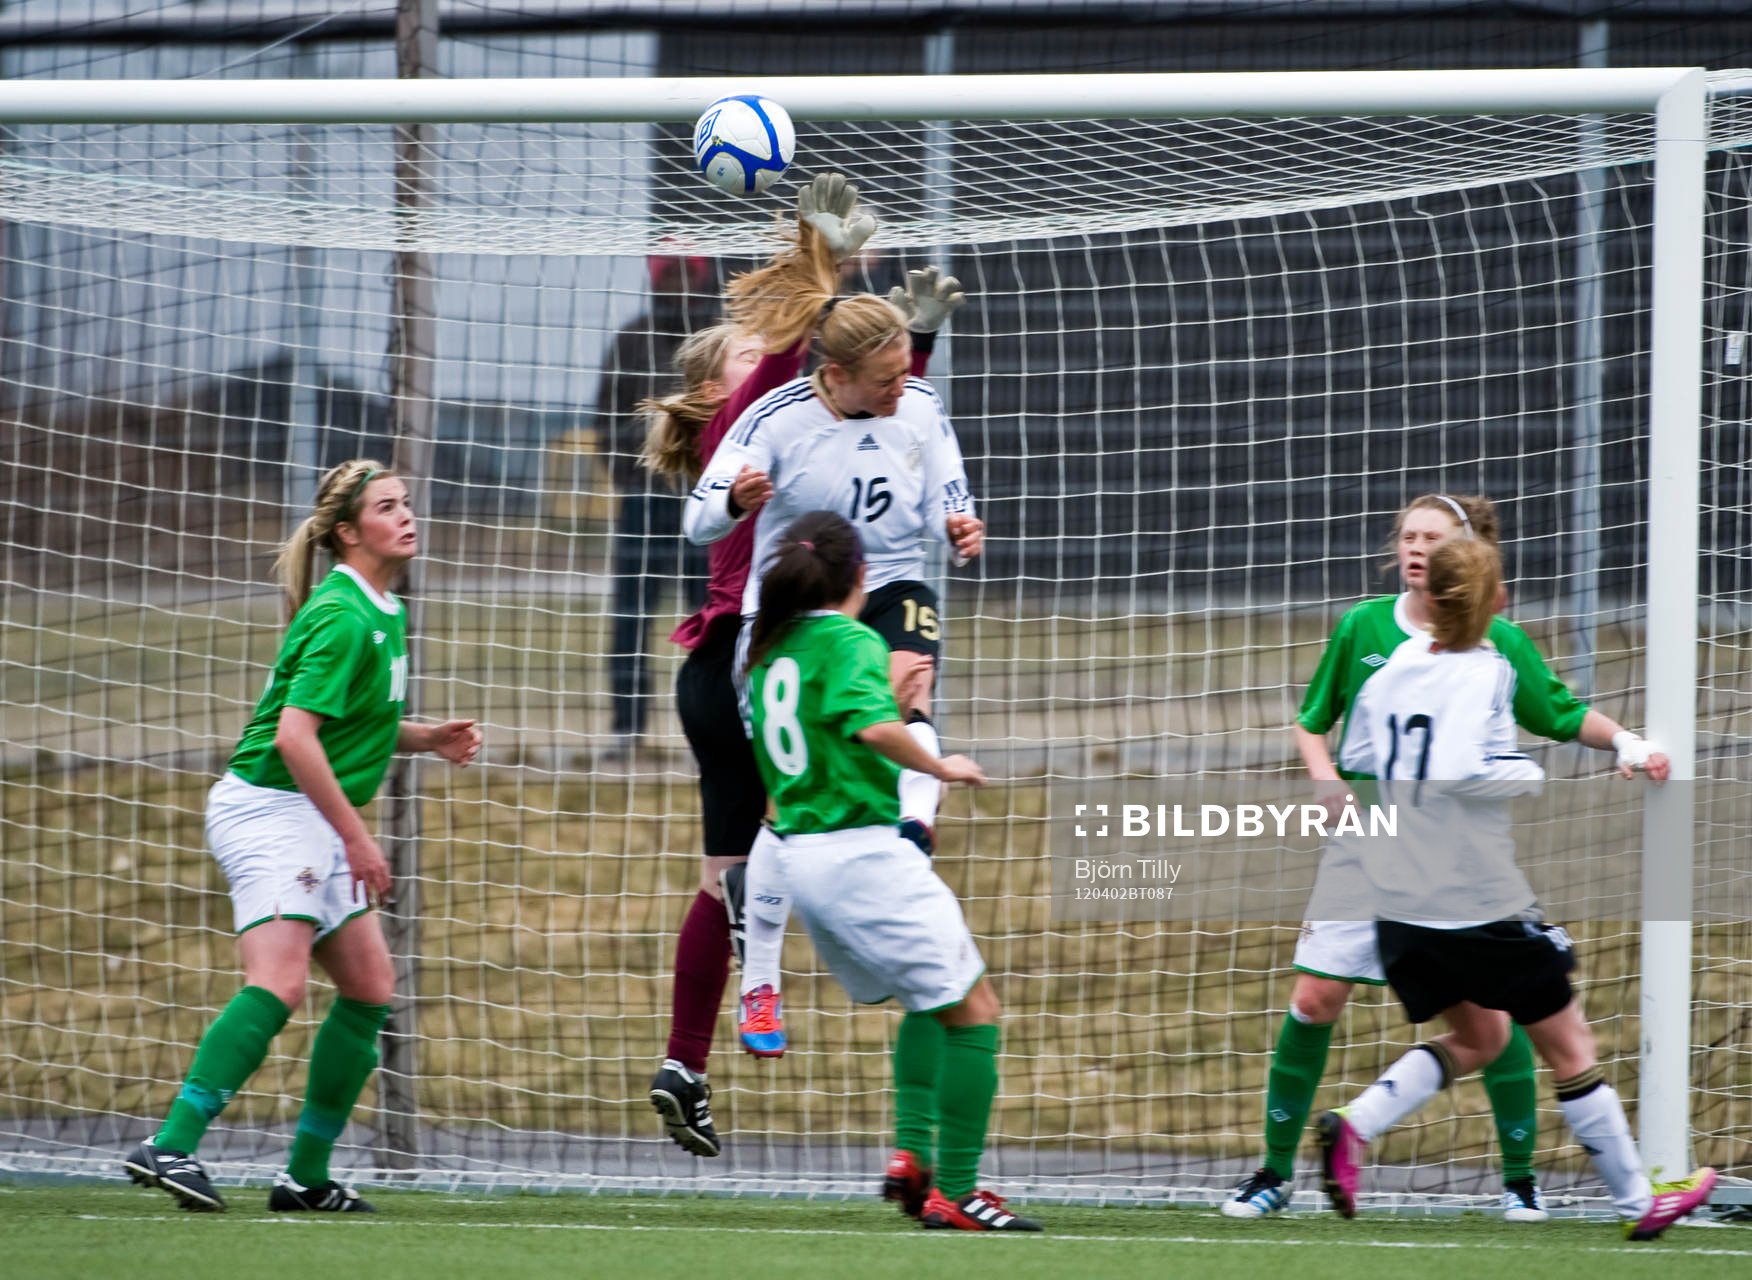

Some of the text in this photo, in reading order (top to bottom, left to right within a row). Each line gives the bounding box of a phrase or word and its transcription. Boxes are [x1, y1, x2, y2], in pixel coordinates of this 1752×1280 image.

[850, 476, 893, 523] 15
[902, 598, 941, 641] 15
[762, 656, 809, 776] 8
[1385, 713, 1434, 808] 17
